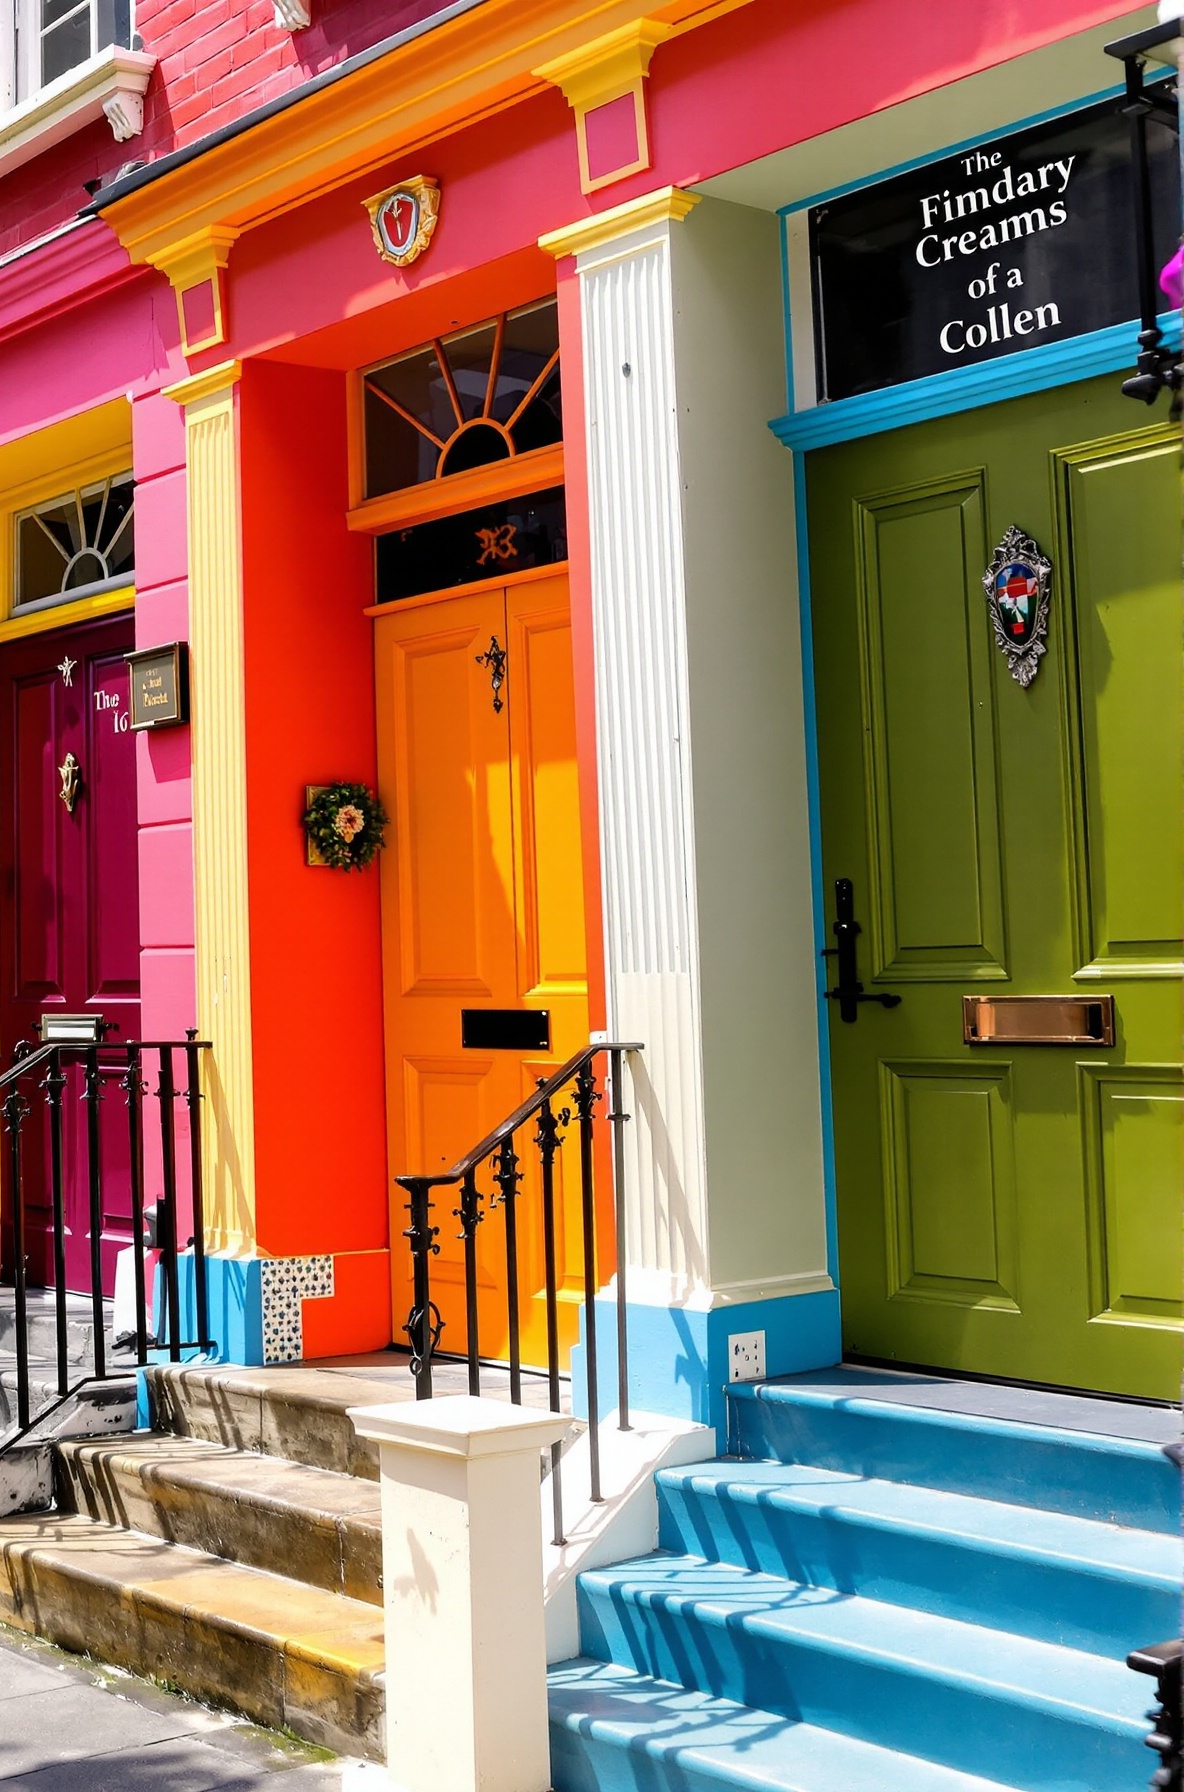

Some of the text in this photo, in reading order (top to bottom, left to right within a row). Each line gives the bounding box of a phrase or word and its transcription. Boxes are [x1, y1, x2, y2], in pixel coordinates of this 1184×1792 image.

[960, 151, 1003, 176] The
[919, 154, 1077, 230] Fimdary
[967, 262, 1024, 299] of a
[939, 302, 1063, 354] Collen
